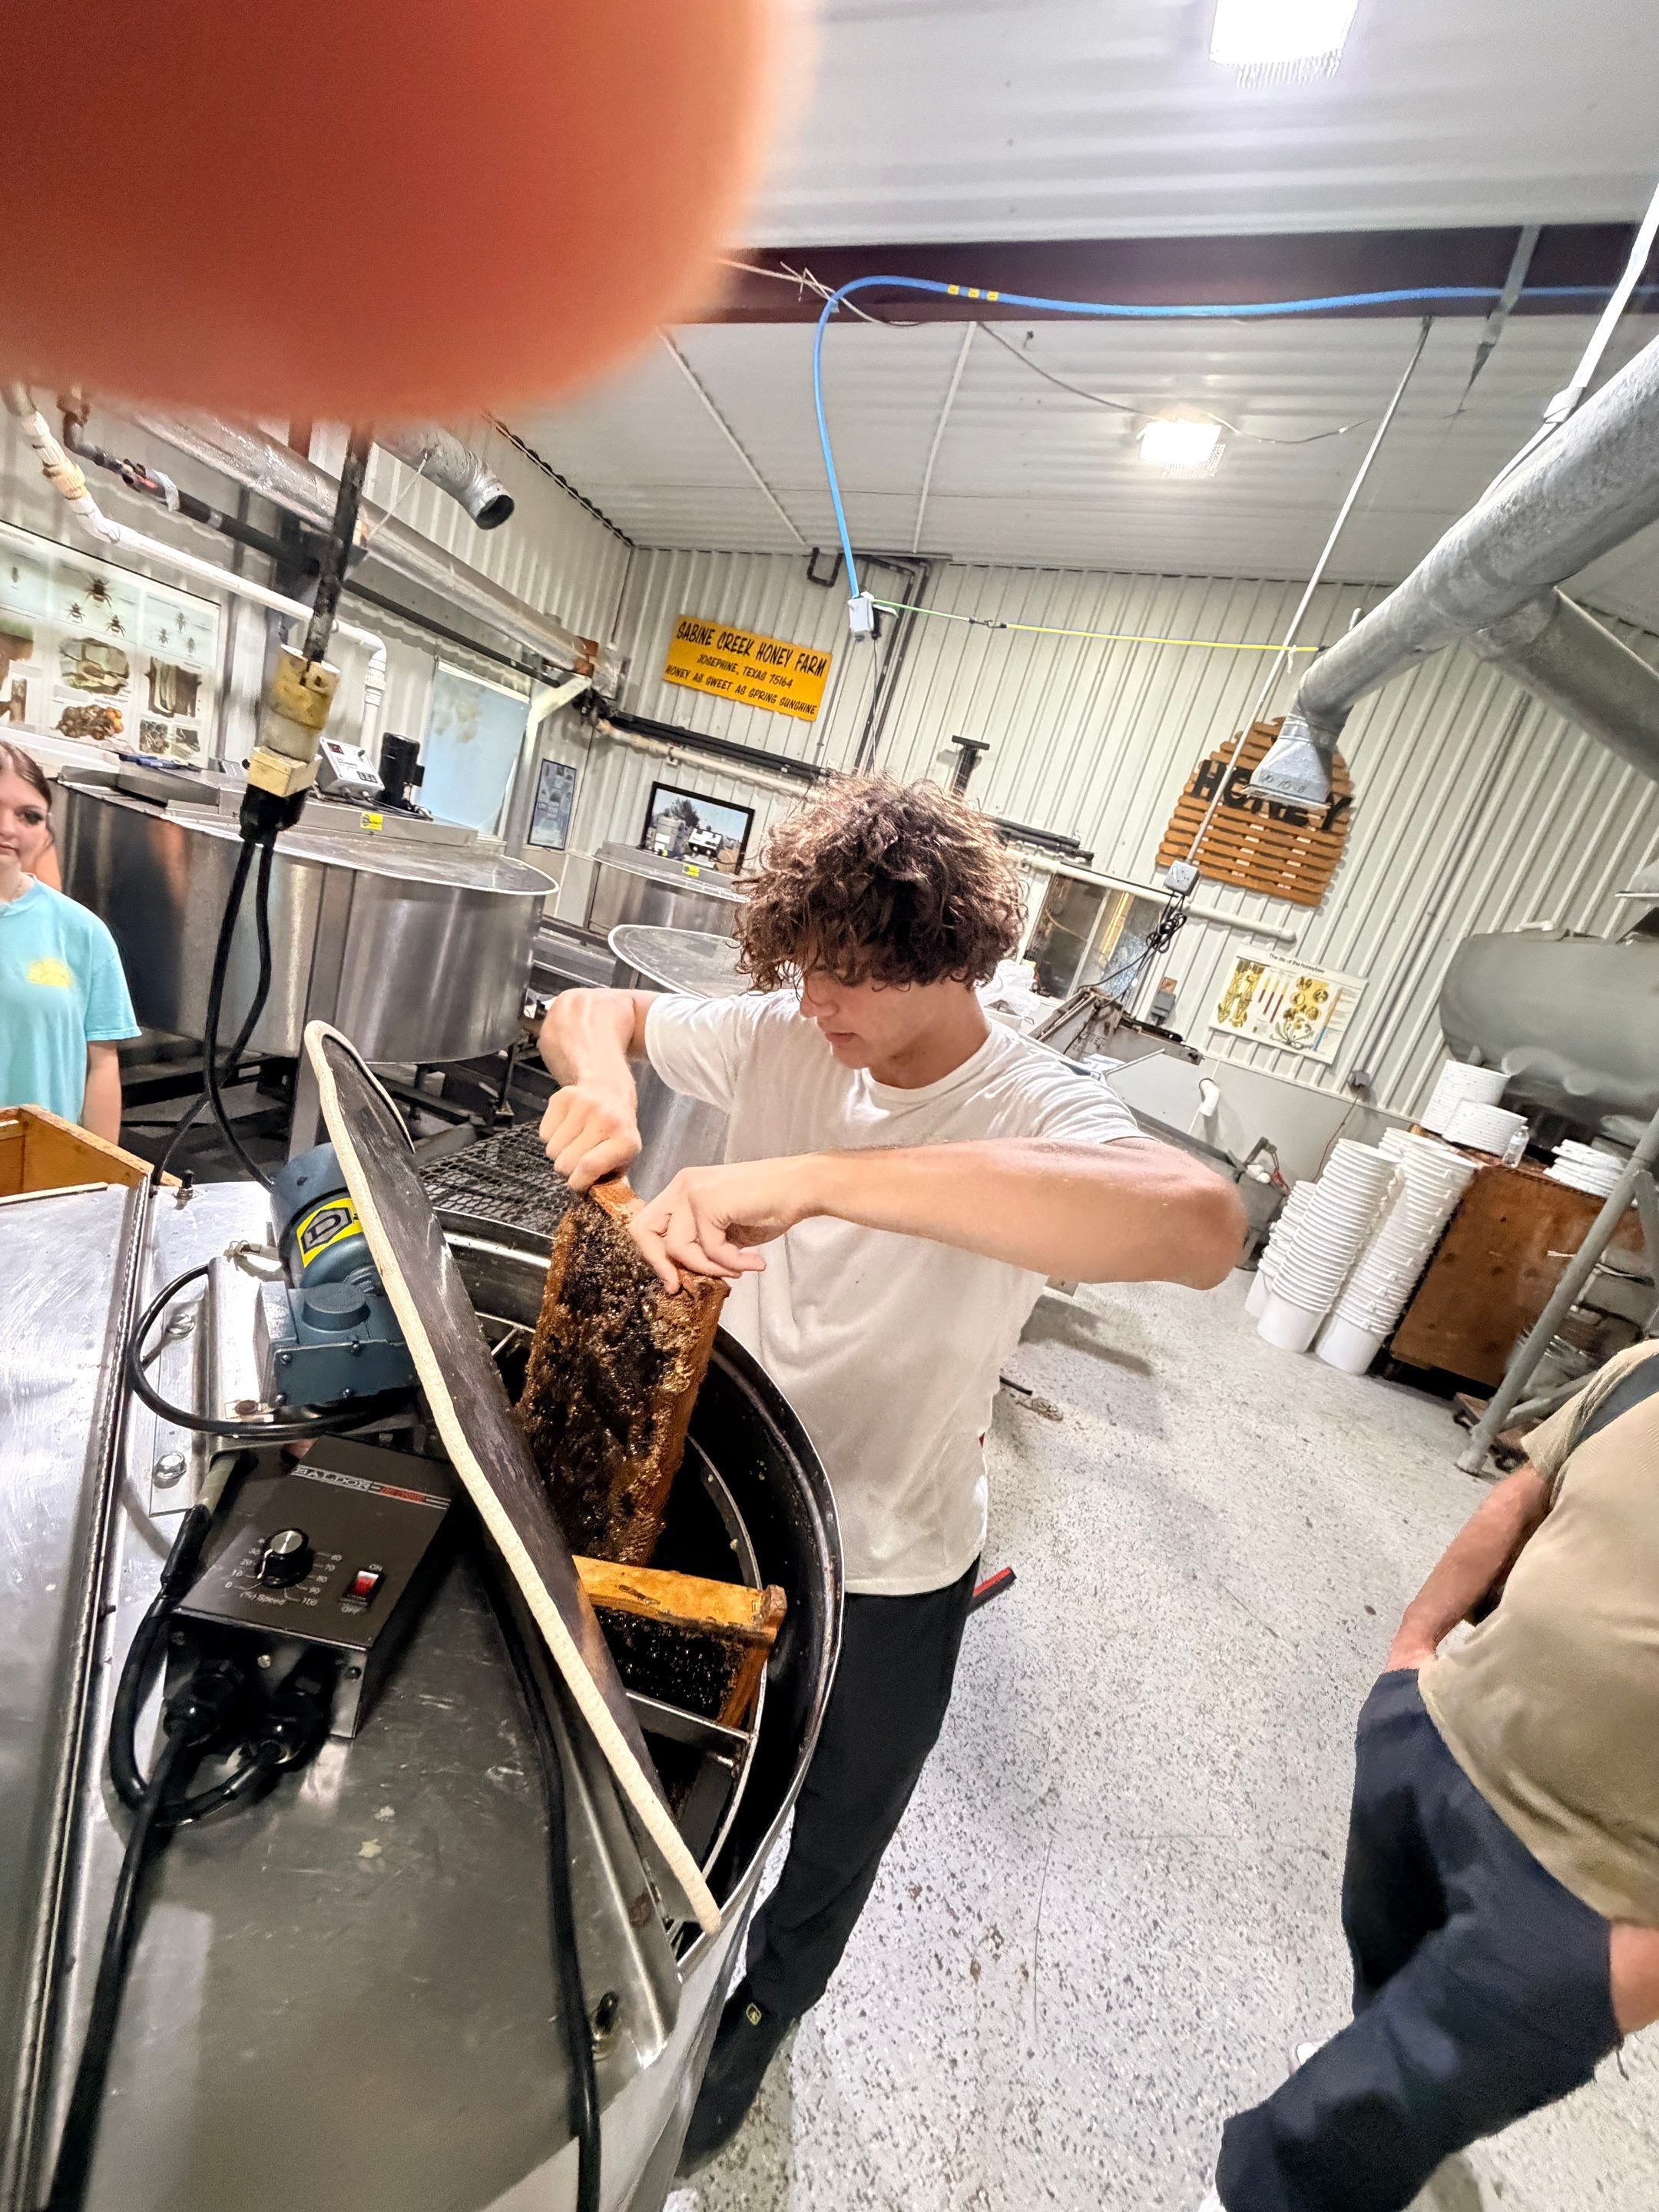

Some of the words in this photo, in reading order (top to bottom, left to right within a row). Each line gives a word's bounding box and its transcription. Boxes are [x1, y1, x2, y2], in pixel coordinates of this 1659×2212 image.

[677, 621, 715, 645] SABINE
[717, 631, 754, 657] CREEK
[756, 642, 793, 668] HONEY
[794, 653, 828, 677] FARM
[697, 654, 739, 675] JOSEPHINE,
[743, 666, 767, 680] TEXAS
[770, 674, 793, 688] 75164
[665, 664, 691, 679] HONEY
[692, 672, 704, 683] AS
[705, 675, 733, 691] SWEET
[734, 684, 747, 695] AS
[748, 688, 777, 704] SPRING
[779, 697, 818, 715] SUNSHINE
